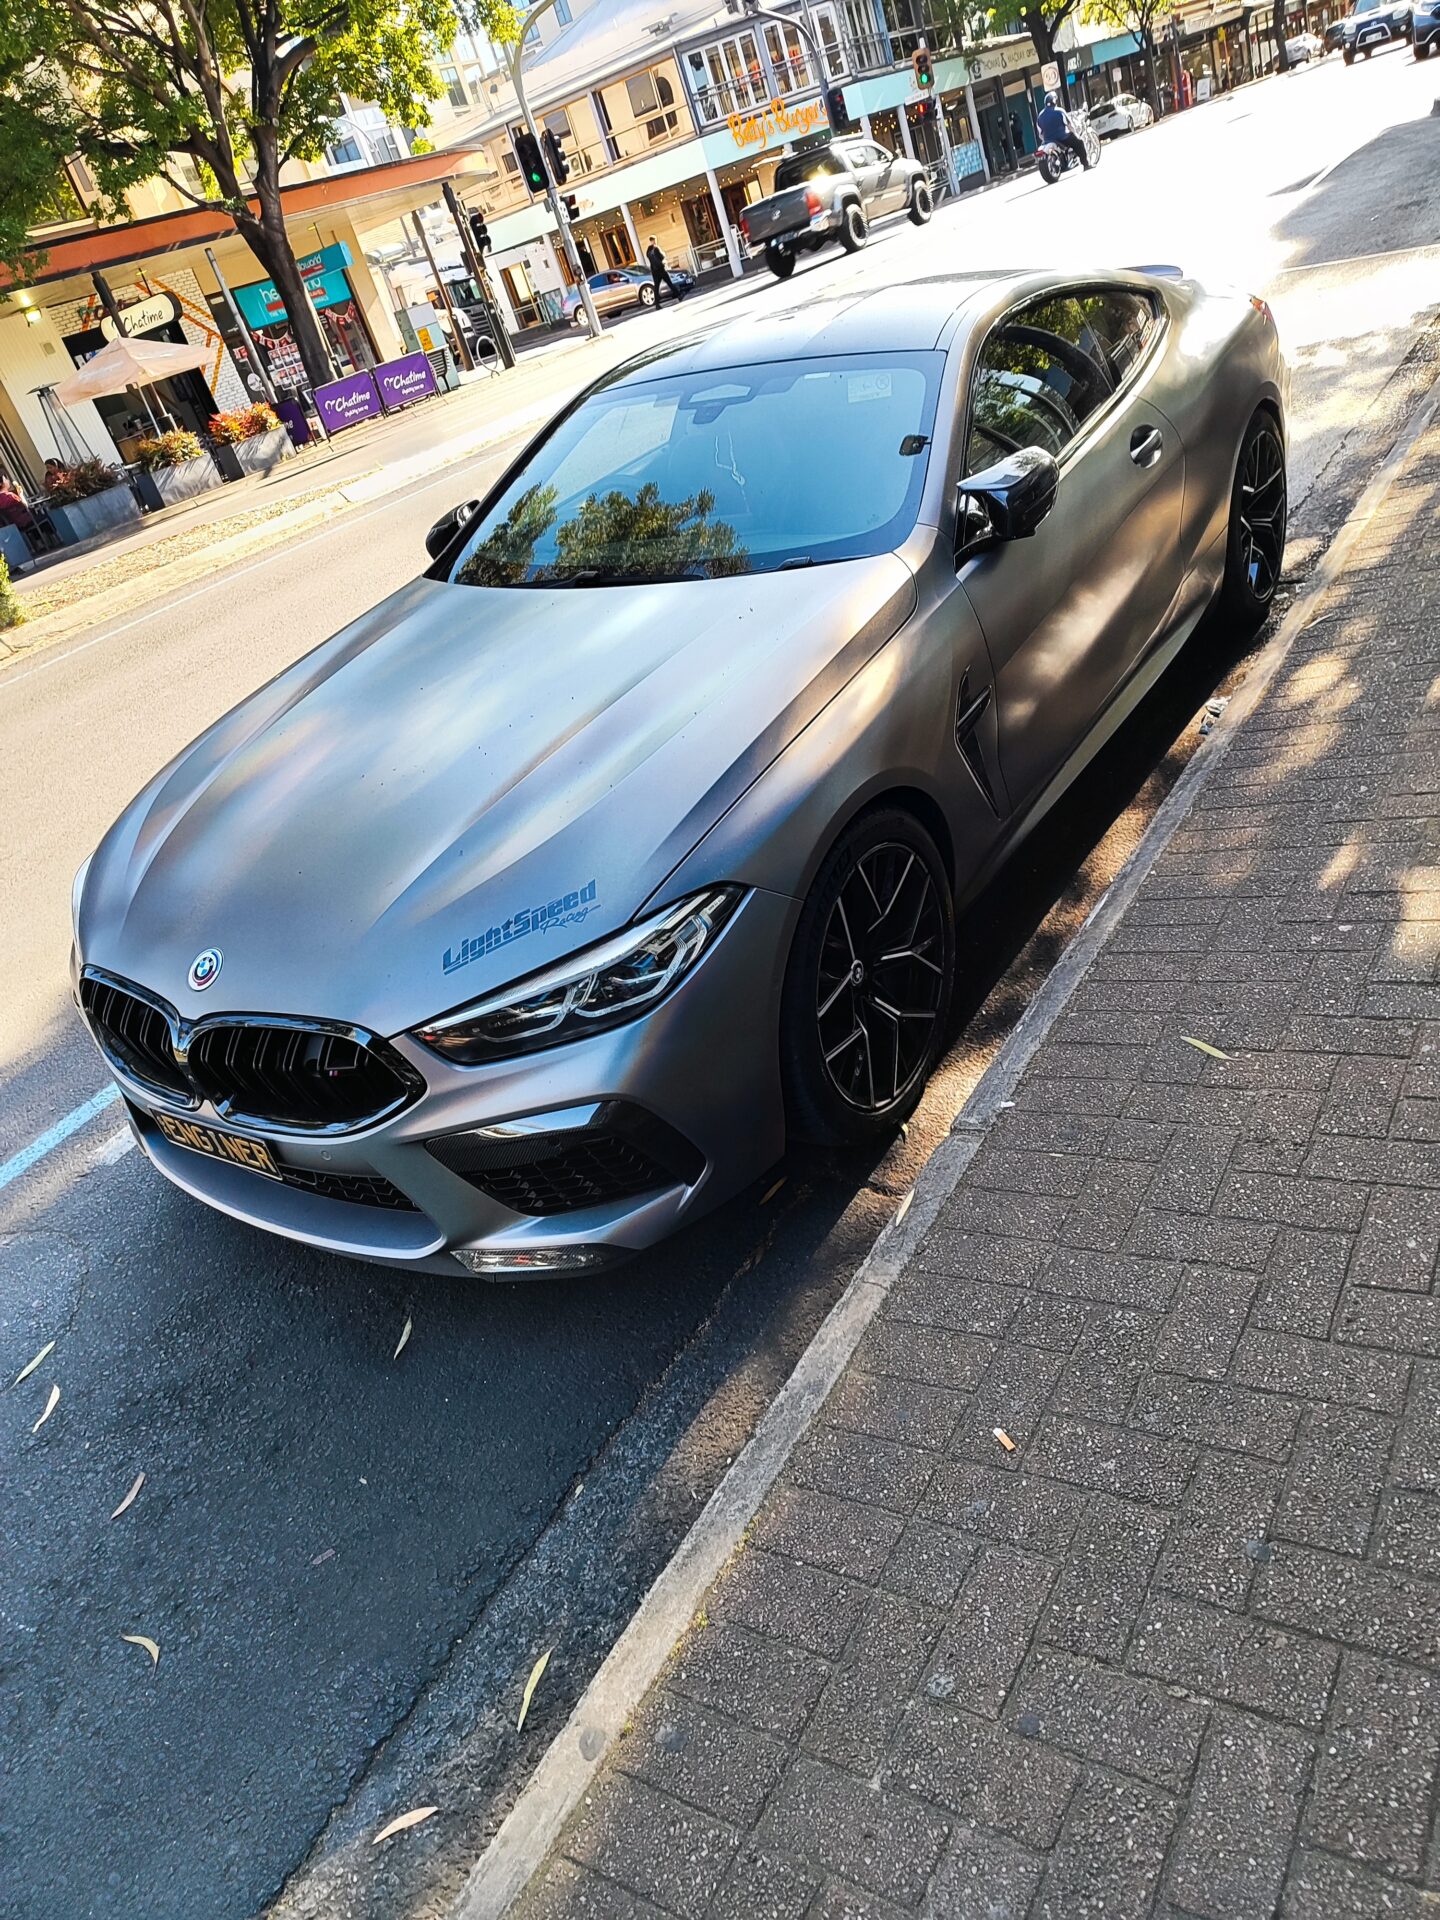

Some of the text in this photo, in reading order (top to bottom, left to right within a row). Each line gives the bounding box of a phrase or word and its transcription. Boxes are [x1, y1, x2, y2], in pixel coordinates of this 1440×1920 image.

[727, 112, 775, 150] Betty's
[123, 310, 163, 335] Chatime
[392, 369, 427, 389] Chatime
[335, 390, 371, 412] Chatime
[443, 878, 597, 975] LightSpeed
[540, 904, 602, 935] Racing
